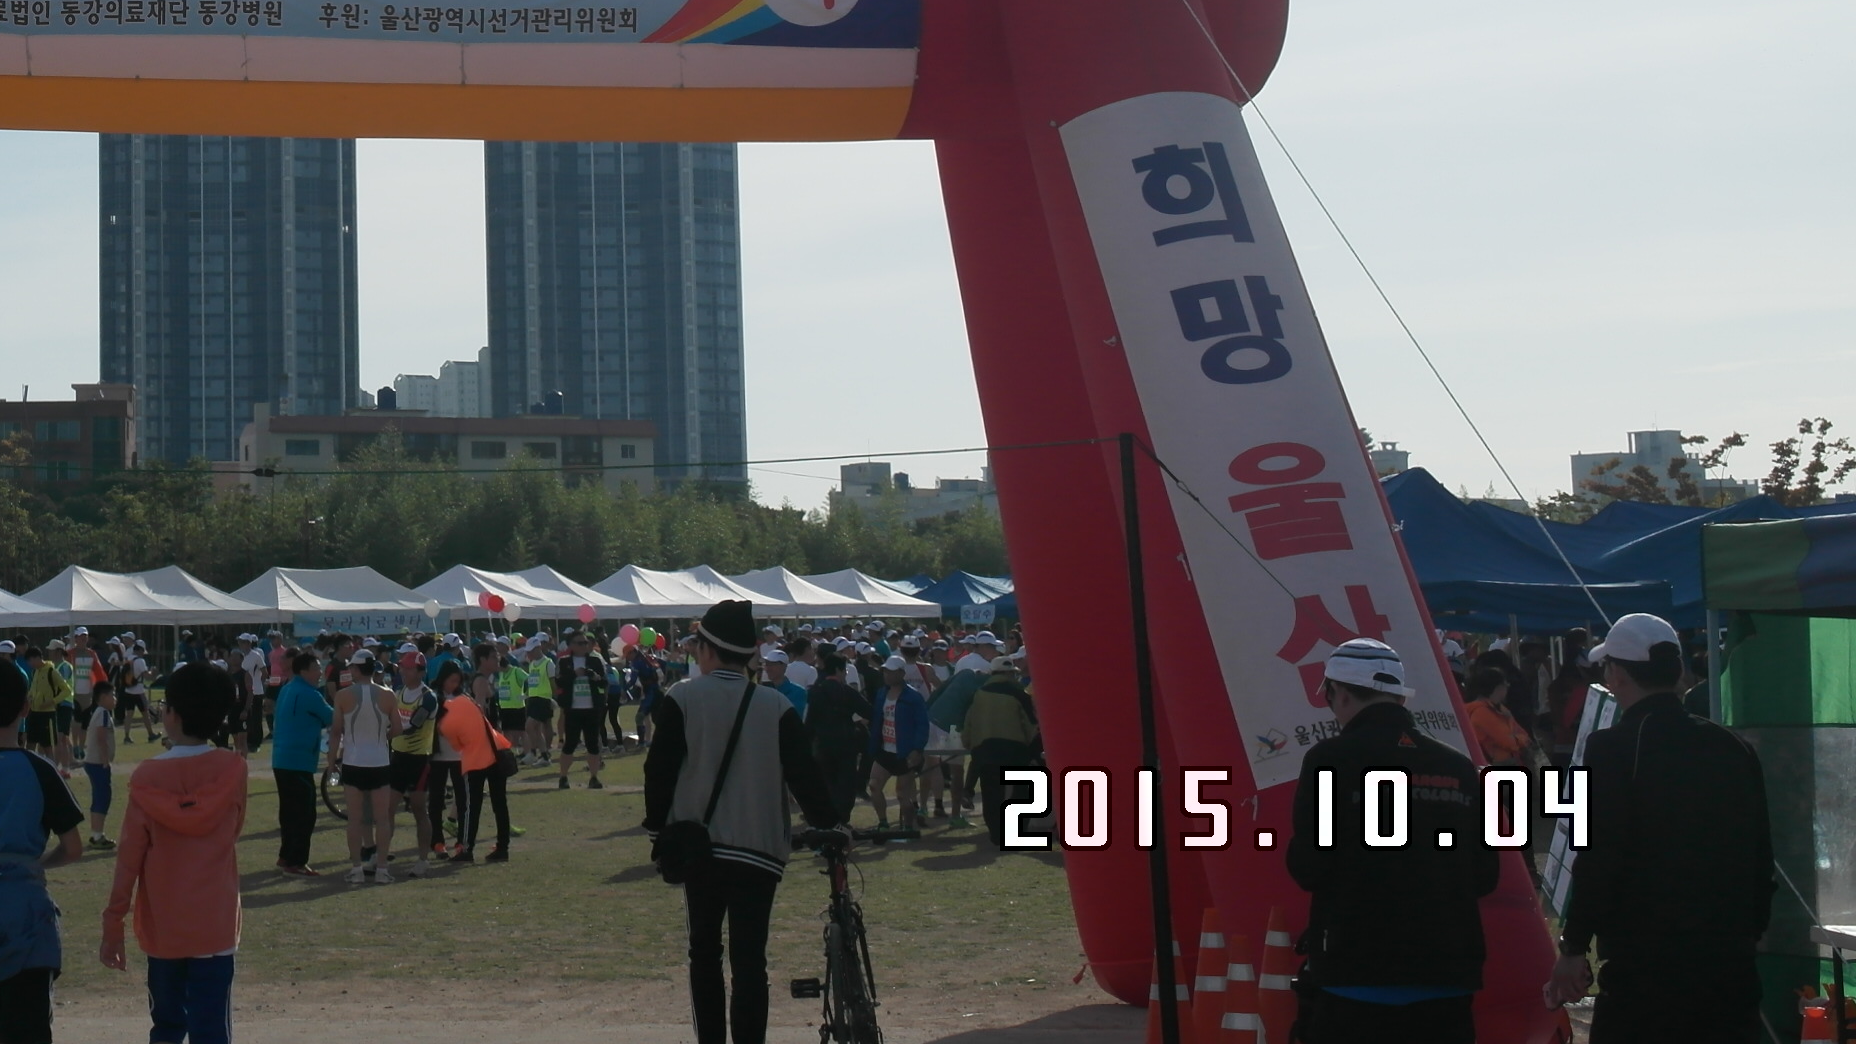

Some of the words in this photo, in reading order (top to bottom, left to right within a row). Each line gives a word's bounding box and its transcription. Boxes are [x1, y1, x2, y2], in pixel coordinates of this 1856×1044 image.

[61, 0, 189, 26] 동강의료재단
[198, 0, 283, 27] 동강병원
[319, 3, 369, 29] 후원:
[379, 6, 638, 34] 울산광역시선거관리위원회
[1131, 141, 1293, 385] 희망
[1228, 441, 1391, 709] 울산
